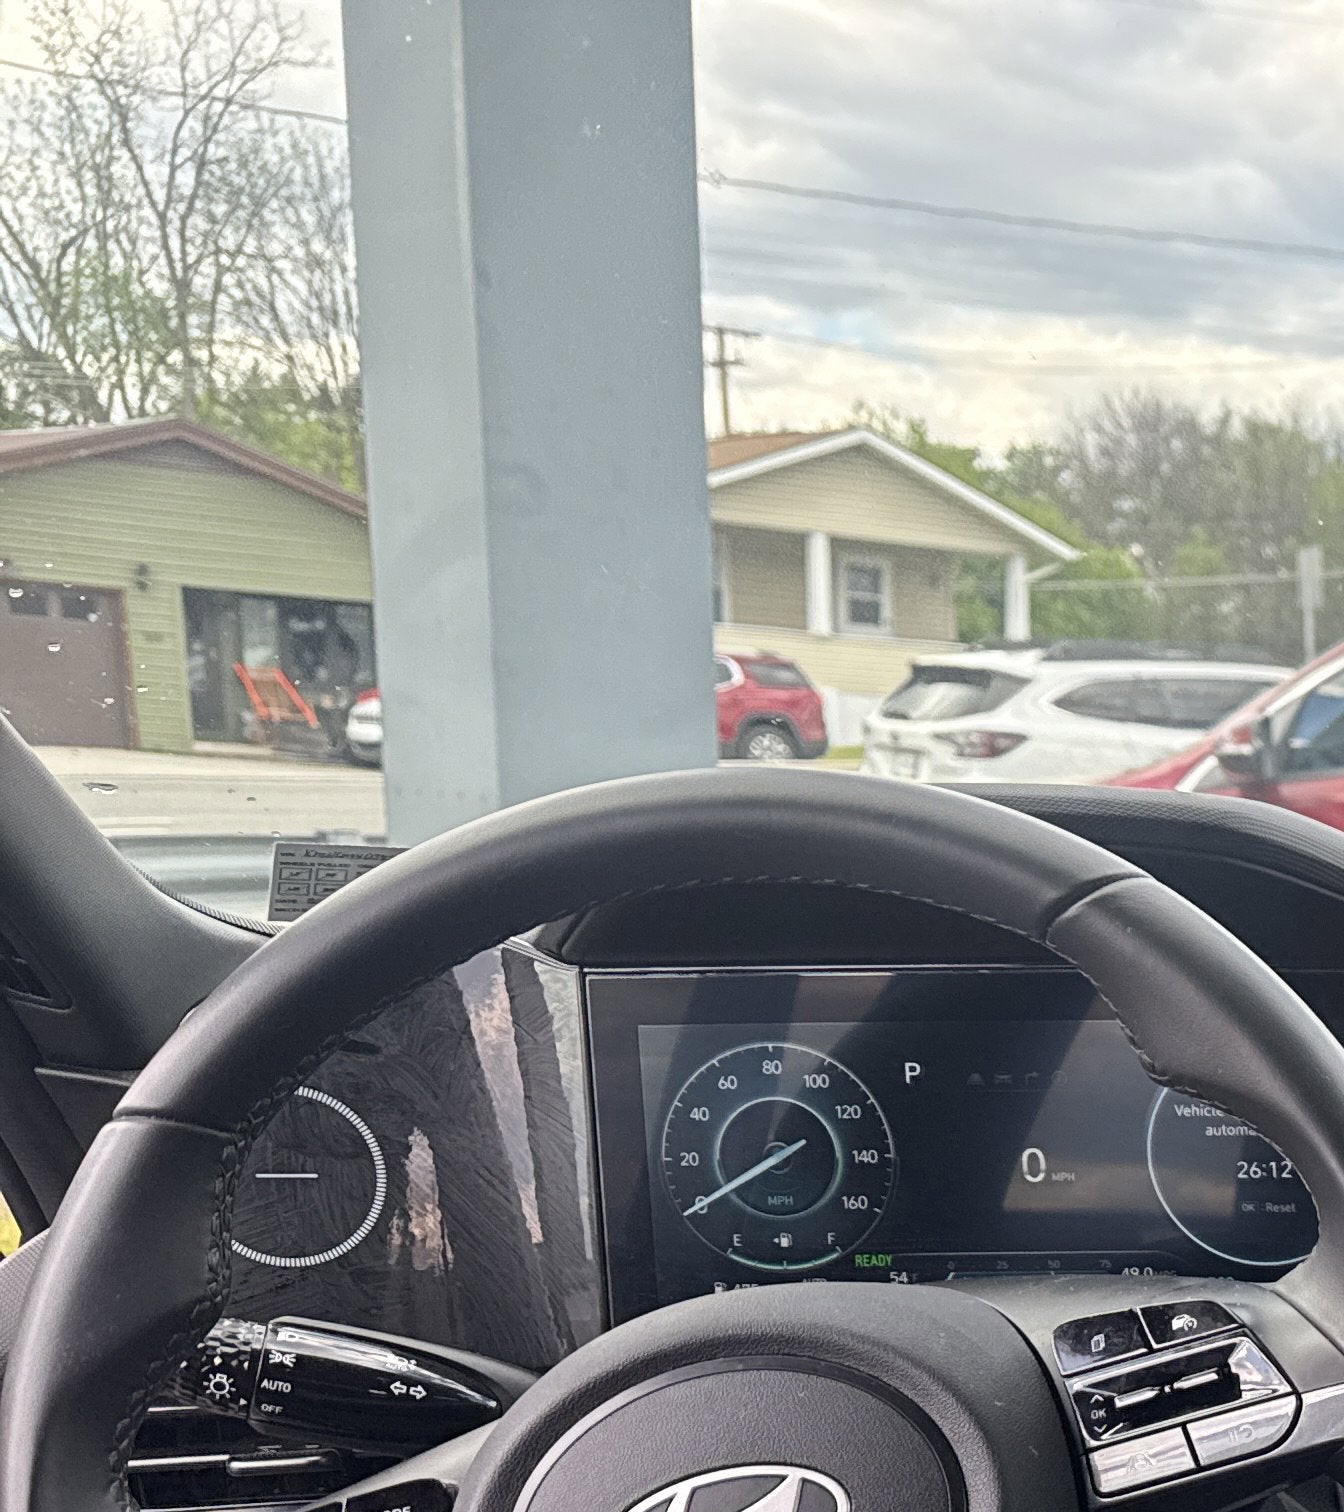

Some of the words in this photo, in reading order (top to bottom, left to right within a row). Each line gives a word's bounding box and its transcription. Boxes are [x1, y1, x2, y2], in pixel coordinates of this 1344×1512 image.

[762, 1060, 782, 1074] 80
[904, 1062, 921, 1084] P
[718, 1075, 738, 1090] 60
[803, 1074, 829, 1089] 100
[690, 1107, 710, 1121] 40
[835, 1104, 861, 1119] 120
[680, 1152, 699, 1166] 20
[852, 1150, 878, 1164] 140
[1022, 1147, 1046, 1183] 0
[1052, 1172, 1075, 1181] MPH
[1237, 1161, 1293, 1179] 26:12
[767, 1196, 793, 1205] MPH
[842, 1196, 868, 1210] 160
[1265, 1202, 1296, 1213] Reset
[733, 1233, 742, 1246] E
[828, 1233, 836, 1244] F
[855, 1254, 892, 1267] READY
[1121, 1267, 1152, 1276] 490
[261, 1378, 291, 1393] AUTO
[261, 1403, 283, 1415] OFF
[1090, 1409, 1107, 1419] OK
